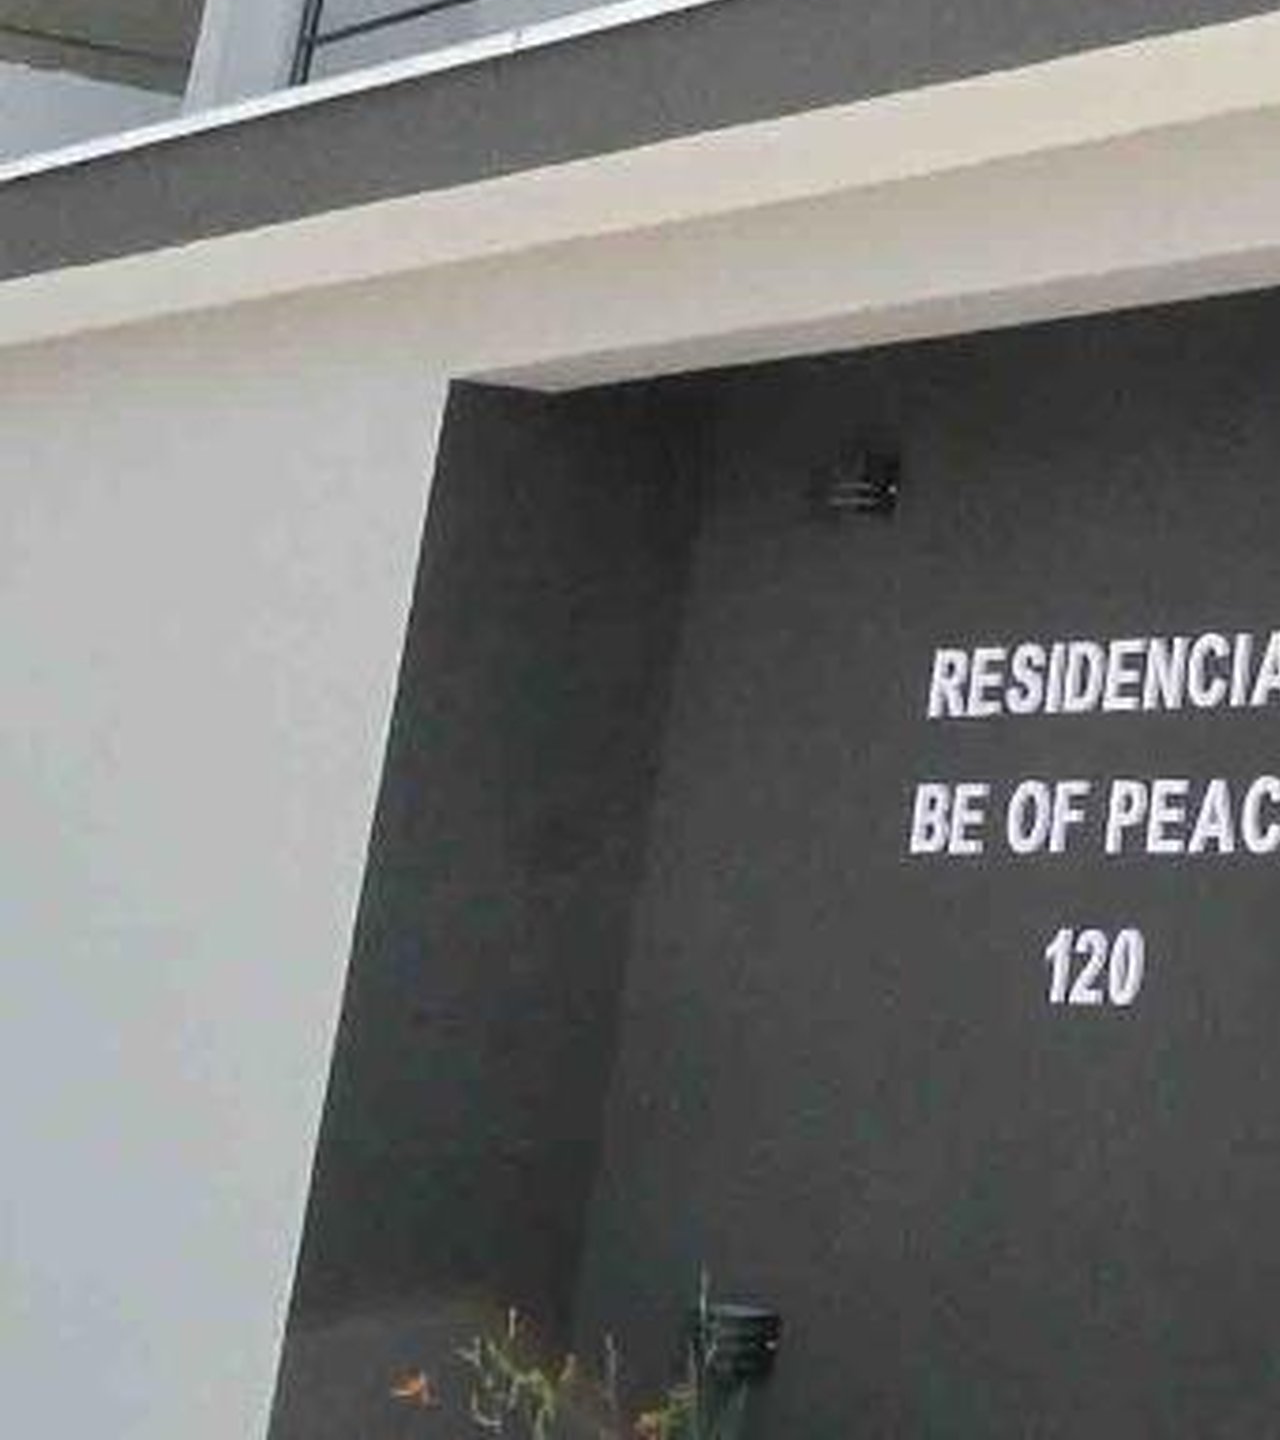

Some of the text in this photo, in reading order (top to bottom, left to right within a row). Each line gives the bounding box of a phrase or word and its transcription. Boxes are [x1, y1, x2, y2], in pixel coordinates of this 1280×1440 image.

[909, 782, 990, 854] BE
[1007, 778, 1091, 854] OF
[1044, 928, 1146, 1006] 120
